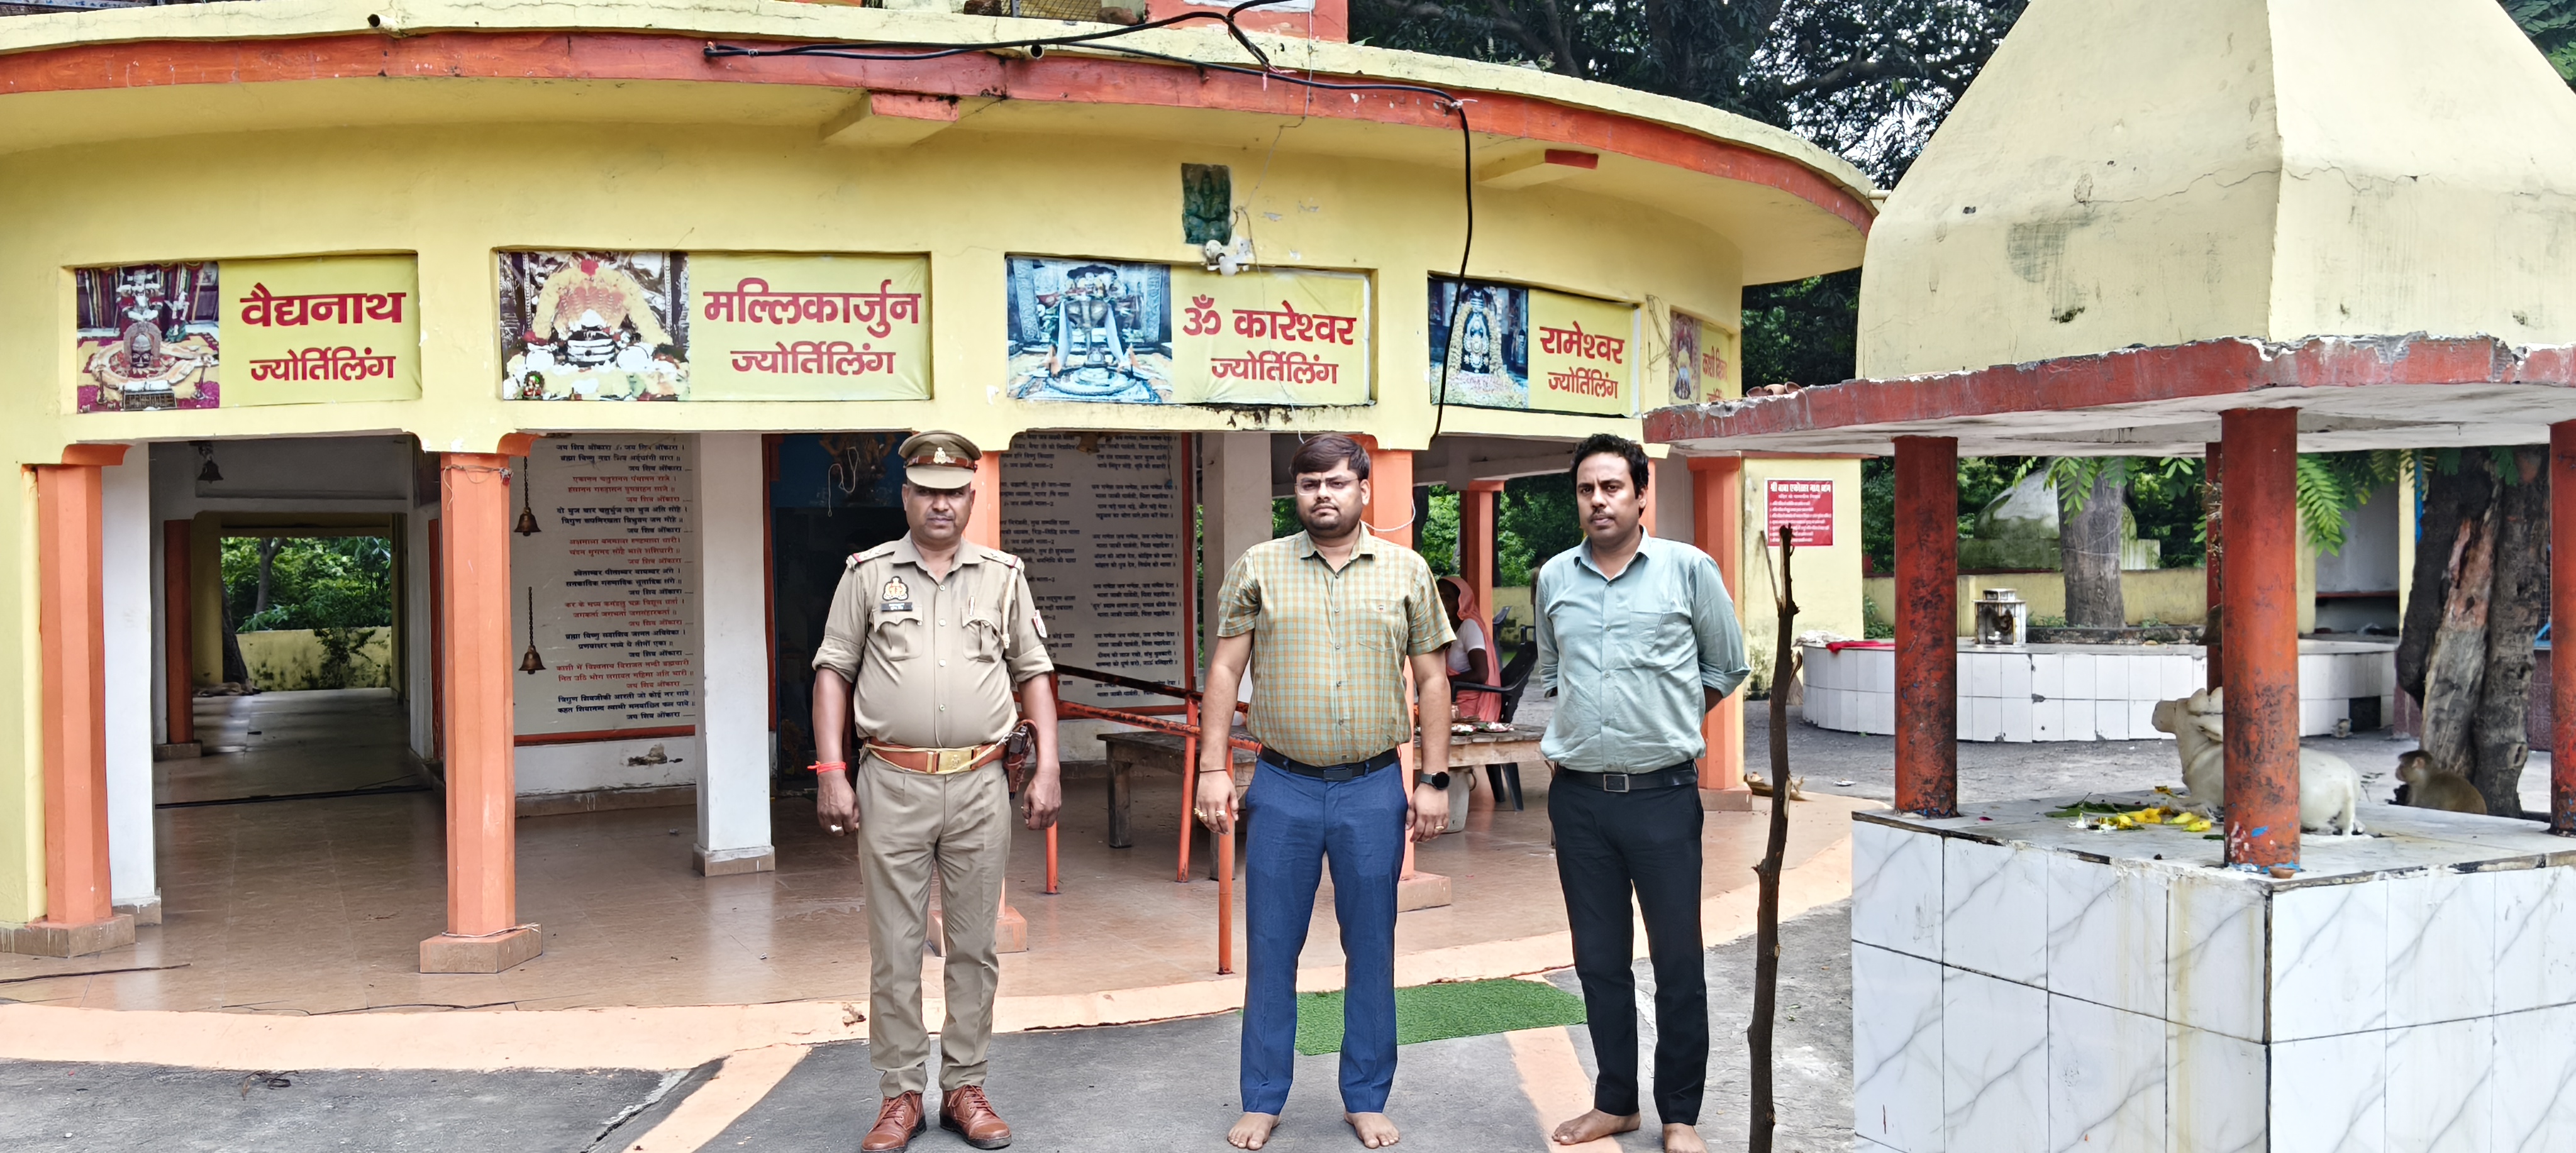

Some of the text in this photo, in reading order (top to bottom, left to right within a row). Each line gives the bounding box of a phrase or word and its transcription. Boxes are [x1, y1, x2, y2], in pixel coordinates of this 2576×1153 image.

[241, 284, 406, 327] वैद्यनाथ
[704, 279, 920, 338] मल्लिकार्जुन
[1184, 297, 1357, 345] ॐ कारेश्वर
[1541, 323, 1624, 363] रामेश्वर
